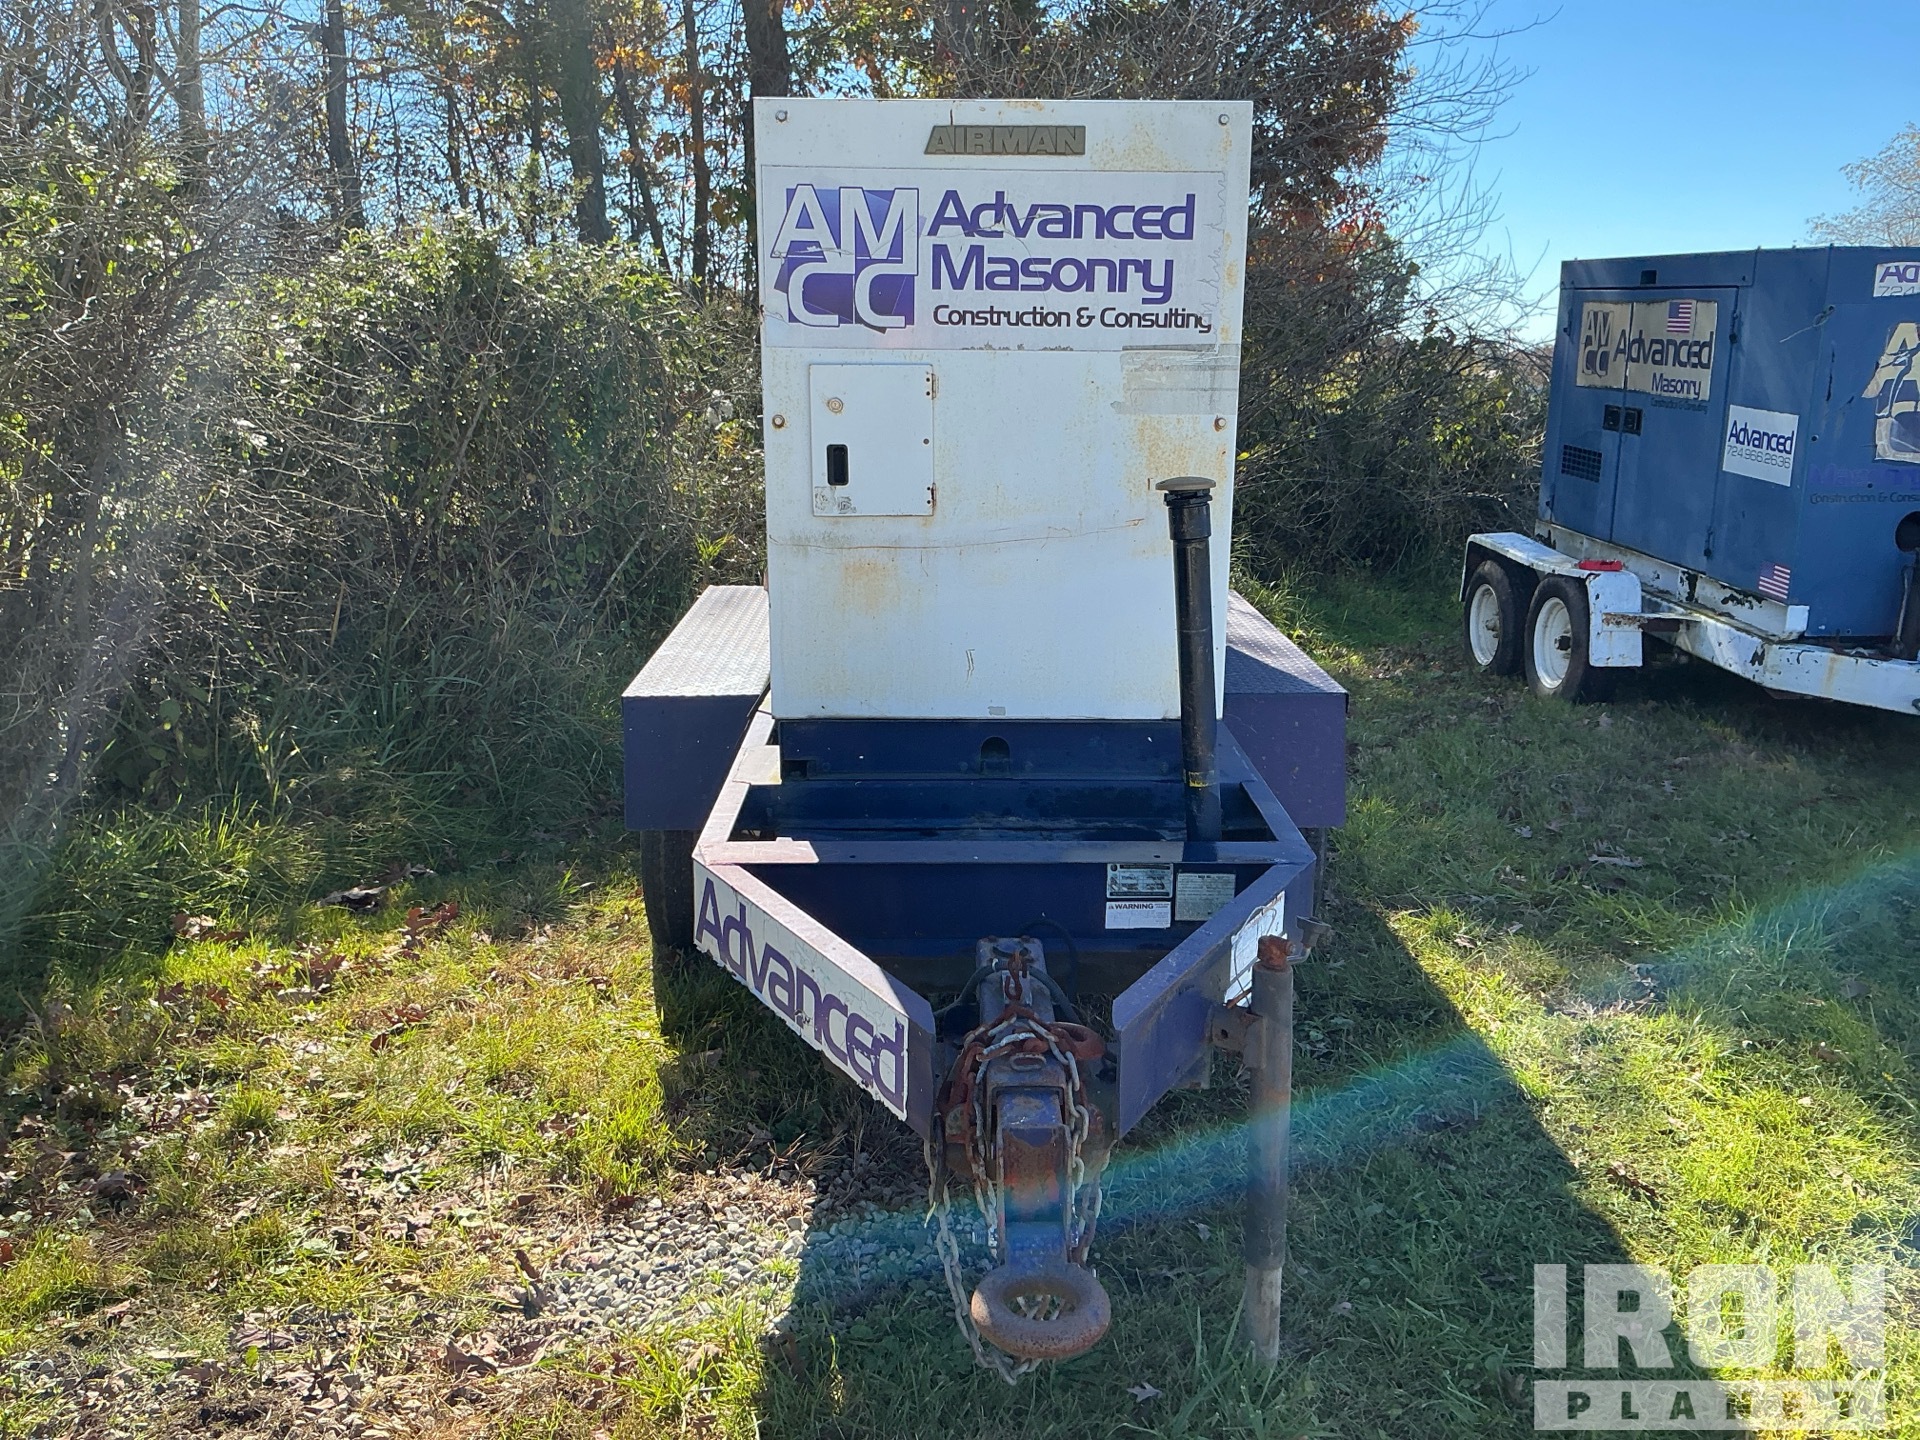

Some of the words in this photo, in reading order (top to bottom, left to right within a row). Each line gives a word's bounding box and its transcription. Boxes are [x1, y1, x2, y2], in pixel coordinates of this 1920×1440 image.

[928, 126, 1085, 154] AIRMAN
[926, 190, 1195, 240] Advanced
[931, 244, 1174, 305] Masonry
[1879, 265, 1920, 283] Ad
[933, 304, 1071, 328] Construction
[1076, 308, 1096, 328] &
[1099, 308, 1212, 334] Consulting
[1613, 329, 1714, 370] Advanced
[1651, 372, 1702, 401] Masonry
[1727, 419, 1795, 455] Advanced
[1726, 444, 1792, 469] 724.966.2636
[695, 876, 907, 1114] Advanced
